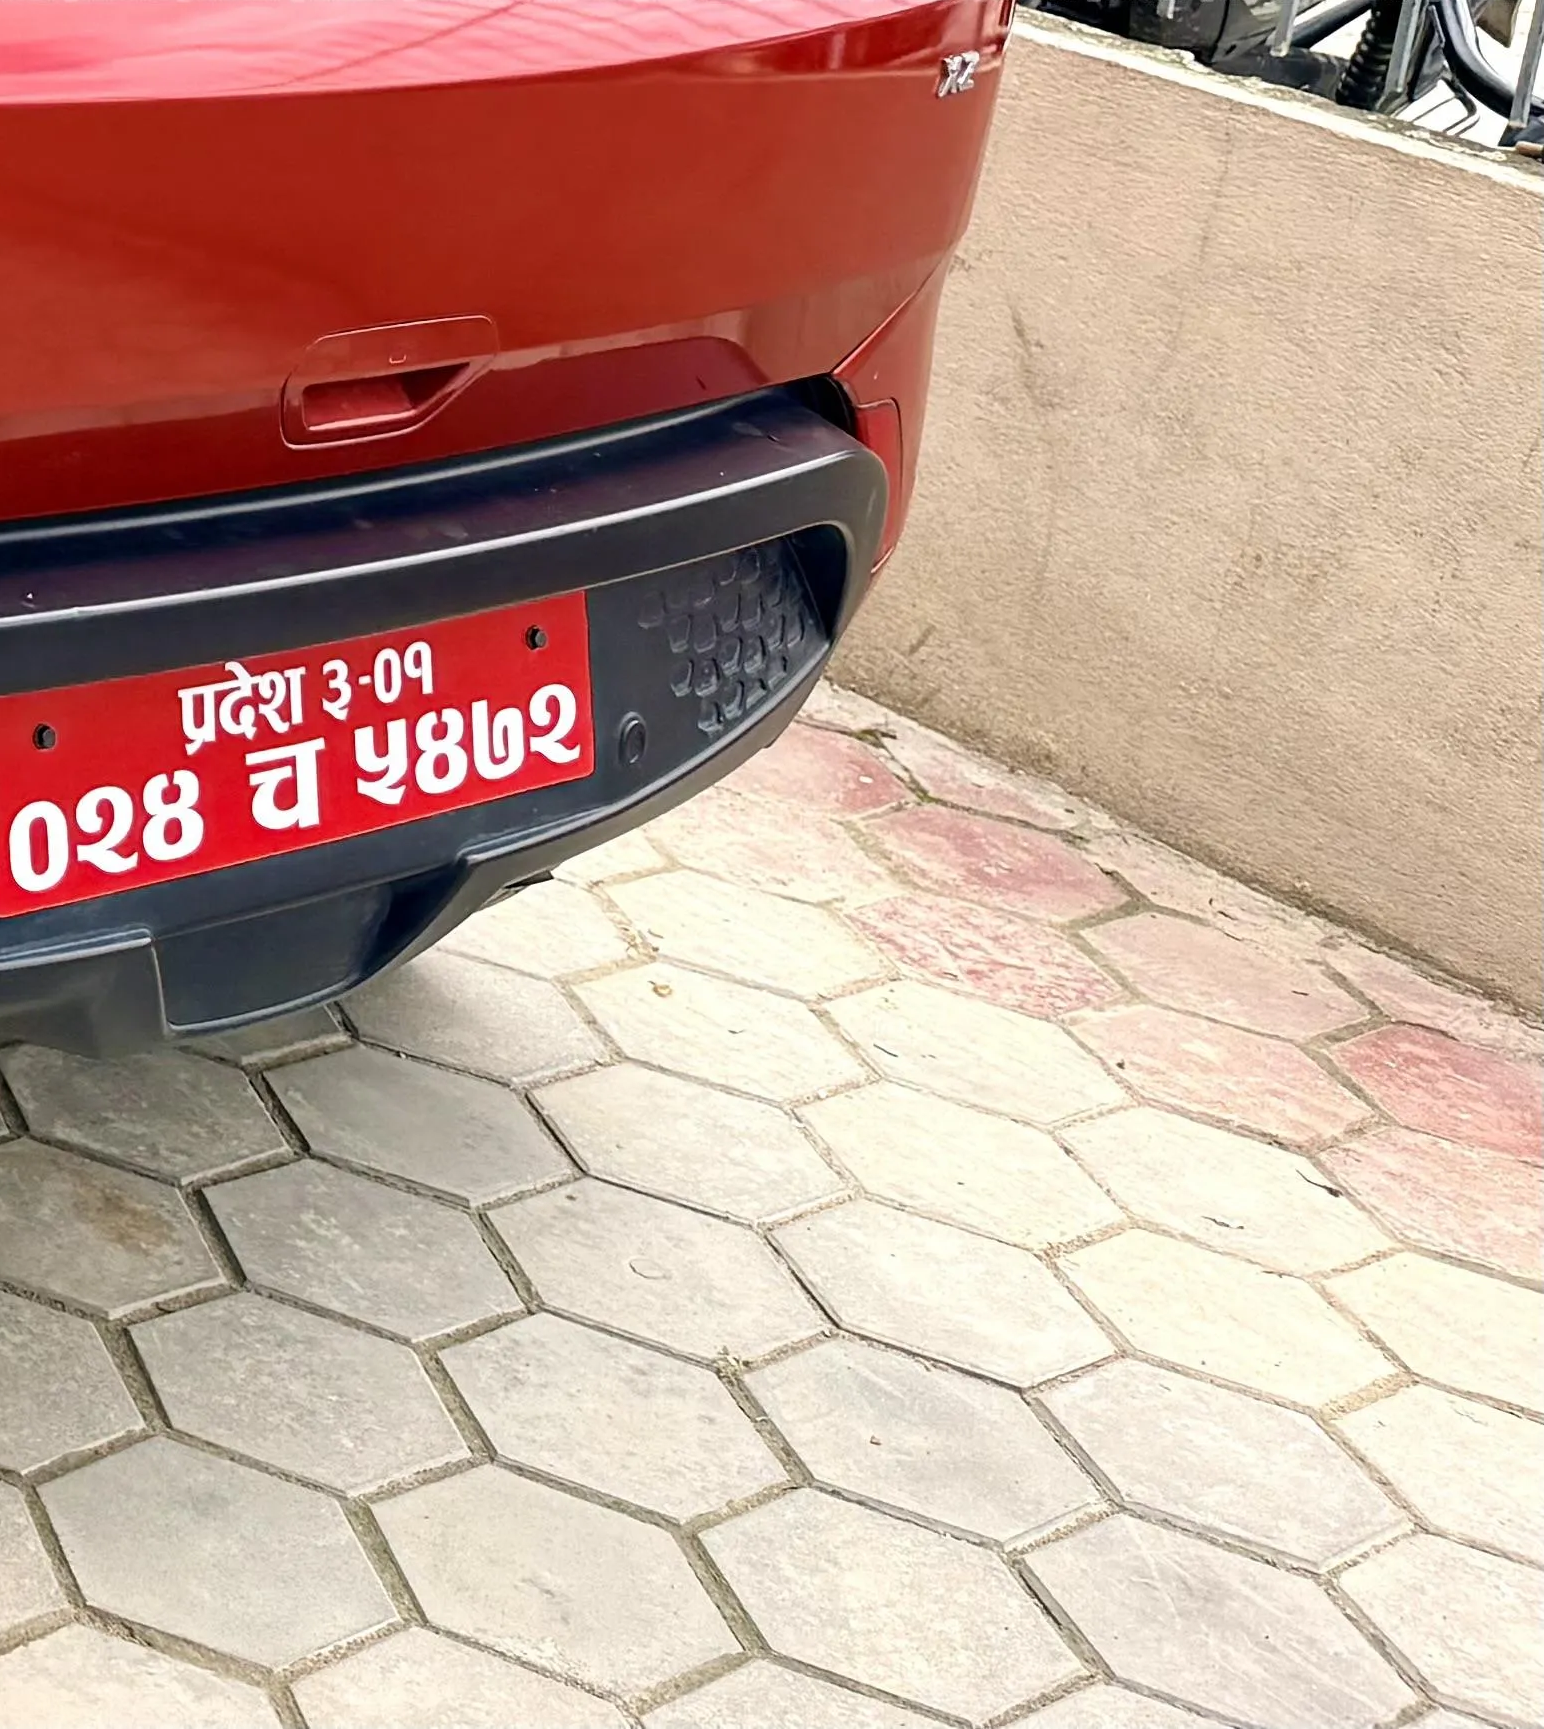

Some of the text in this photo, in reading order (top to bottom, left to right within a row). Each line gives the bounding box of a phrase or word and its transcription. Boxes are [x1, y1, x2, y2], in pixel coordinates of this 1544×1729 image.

[177, 641, 433, 756] प्रदेश ३-०१
[9, 683, 581, 893] ०२४ च ५४७२
